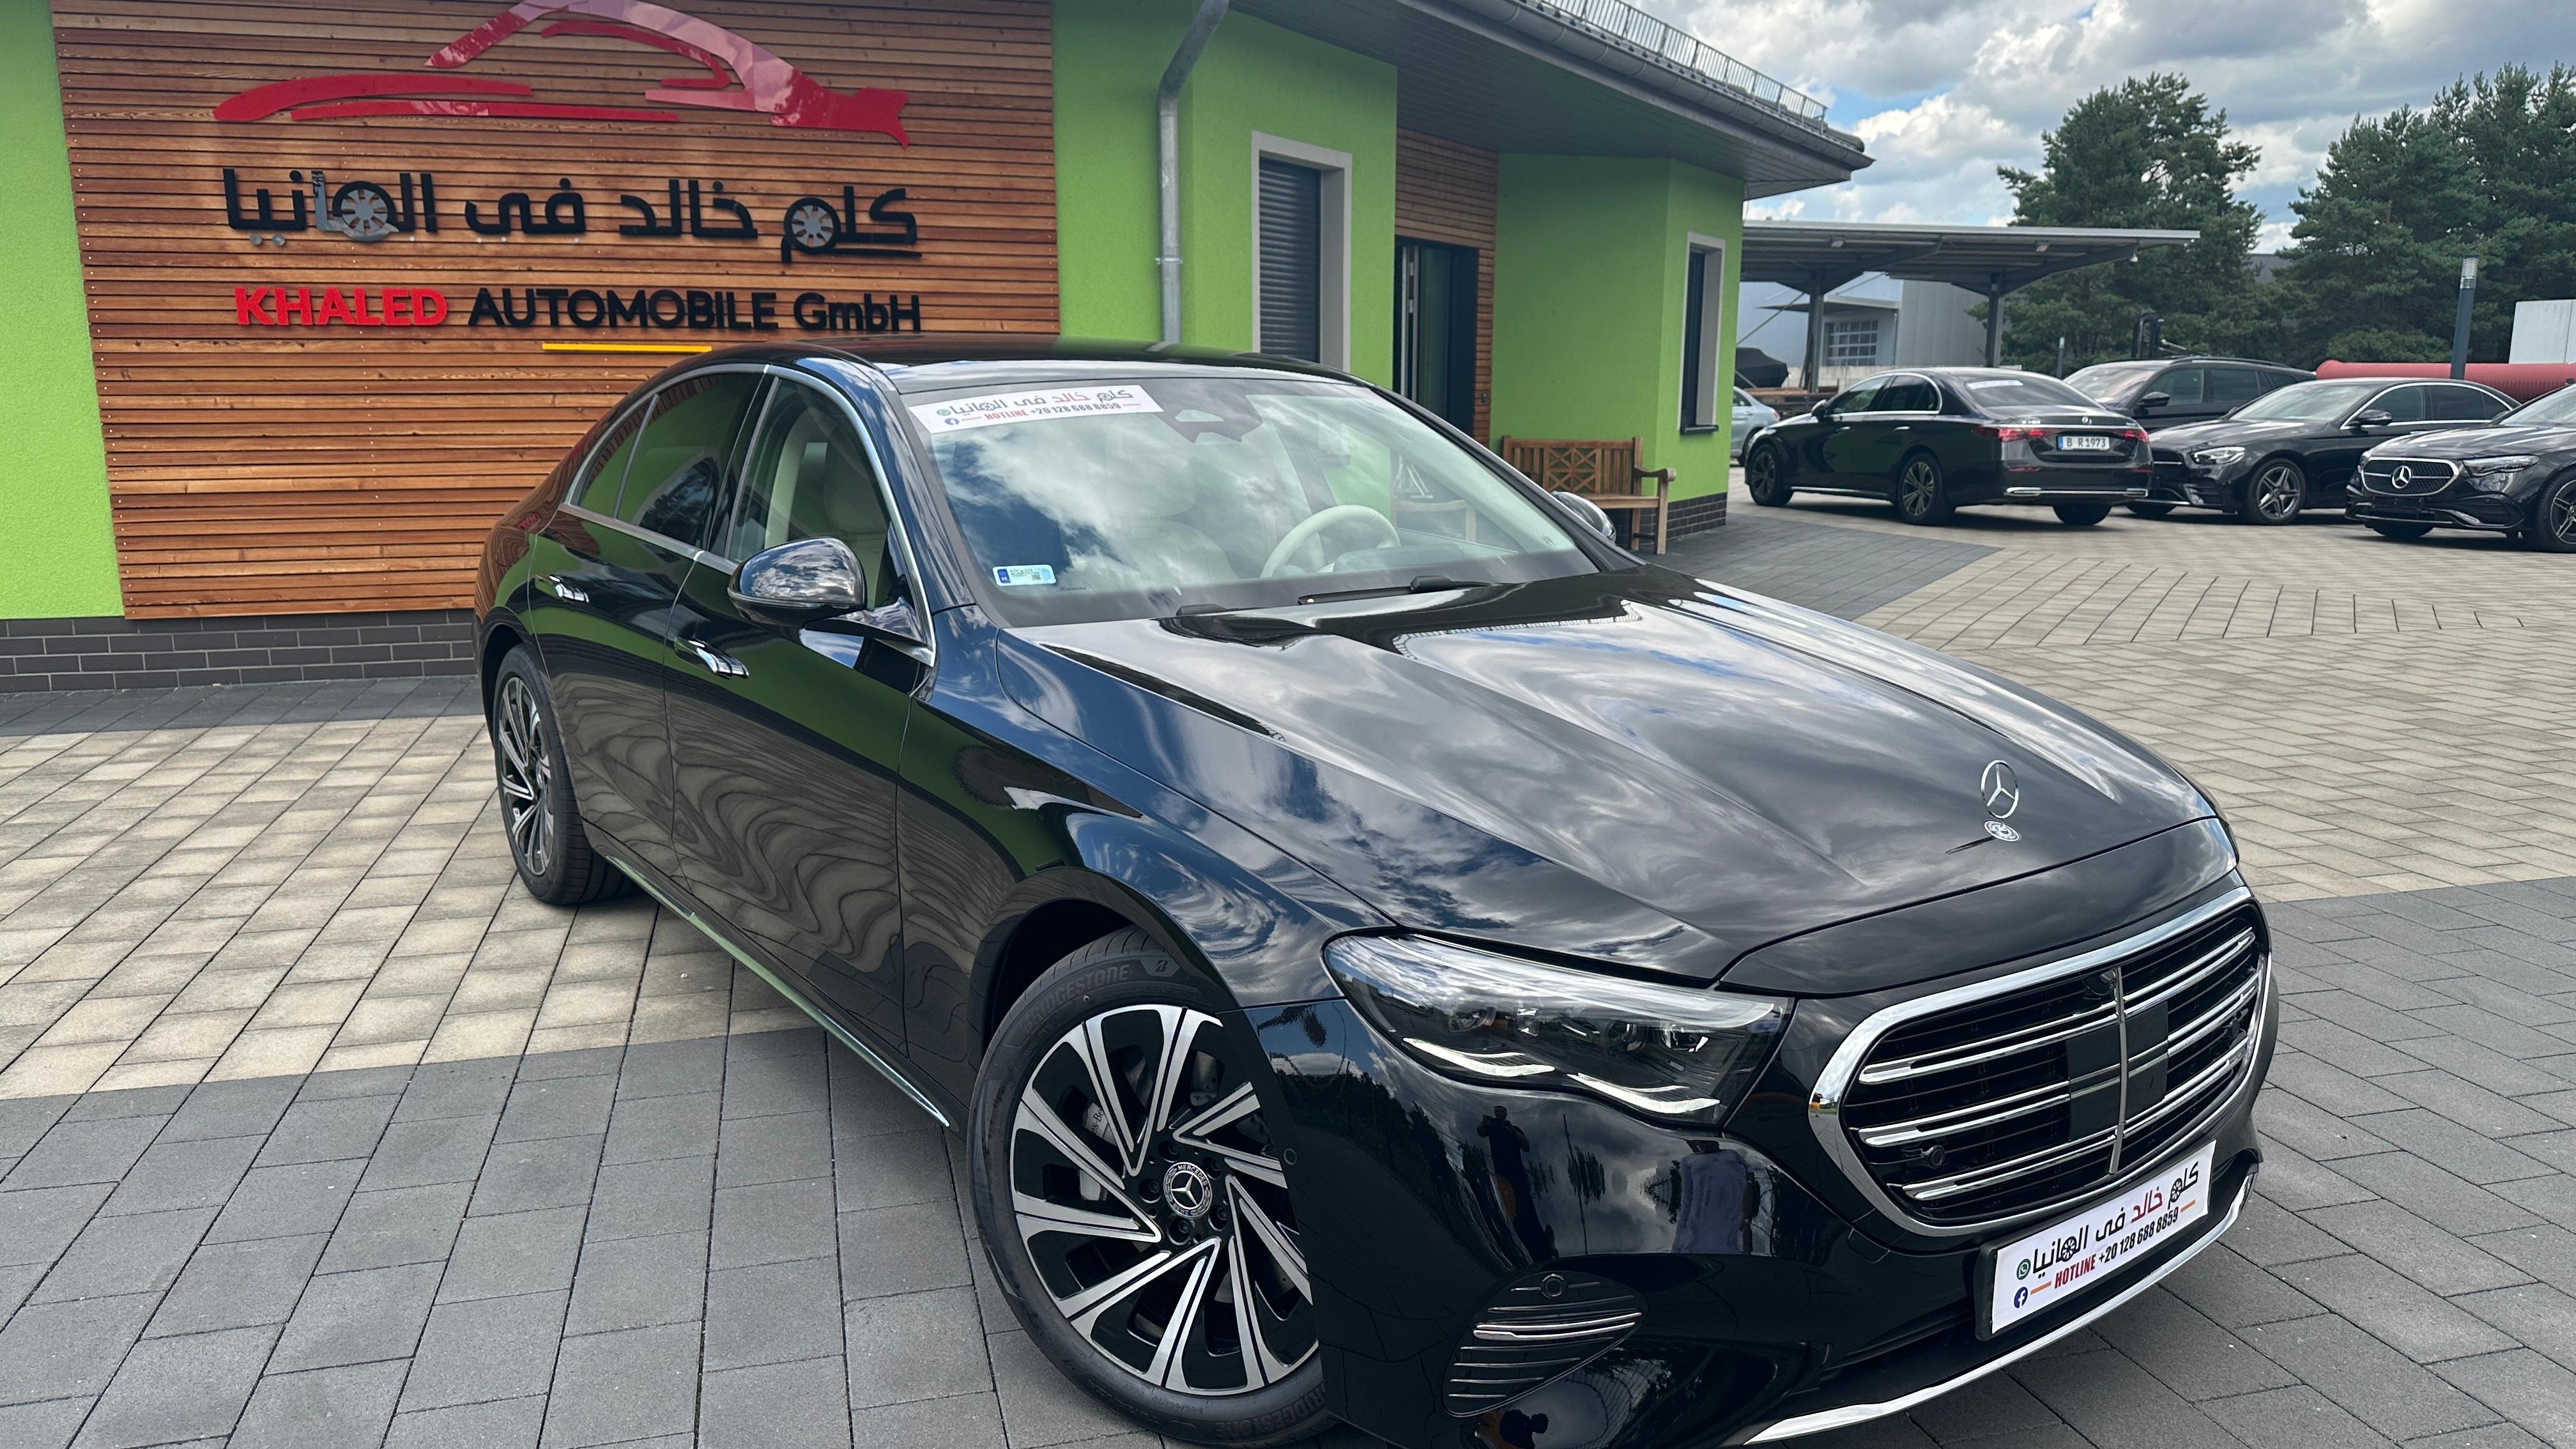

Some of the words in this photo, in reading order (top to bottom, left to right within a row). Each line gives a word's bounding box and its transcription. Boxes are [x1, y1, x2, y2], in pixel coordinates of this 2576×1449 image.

[619, 179, 758, 238] خالد
[234, 287, 448, 326] KHALED
[468, 288, 779, 330] AUTOMOBILE
[793, 292, 921, 332] GmbH
[984, 410, 1029, 420] HOTLINE
[1052, 392, 1091, 402] خالد
[2066, 438, 2073, 447] B
[1023, 963, 1130, 1034] BRIDGESTONE
[1177, 1164, 1208, 1186] MERCEDES
[2131, 1186, 2163, 1223] خالد
[2054, 1254, 2097, 1289] HOTLINE
[2098, 1245, 2117, 1264] +20
[2119, 1234, 2135, 1256] 128
[2137, 1221, 2154, 1243] 688
[2156, 1206, 2179, 1234] 8859
